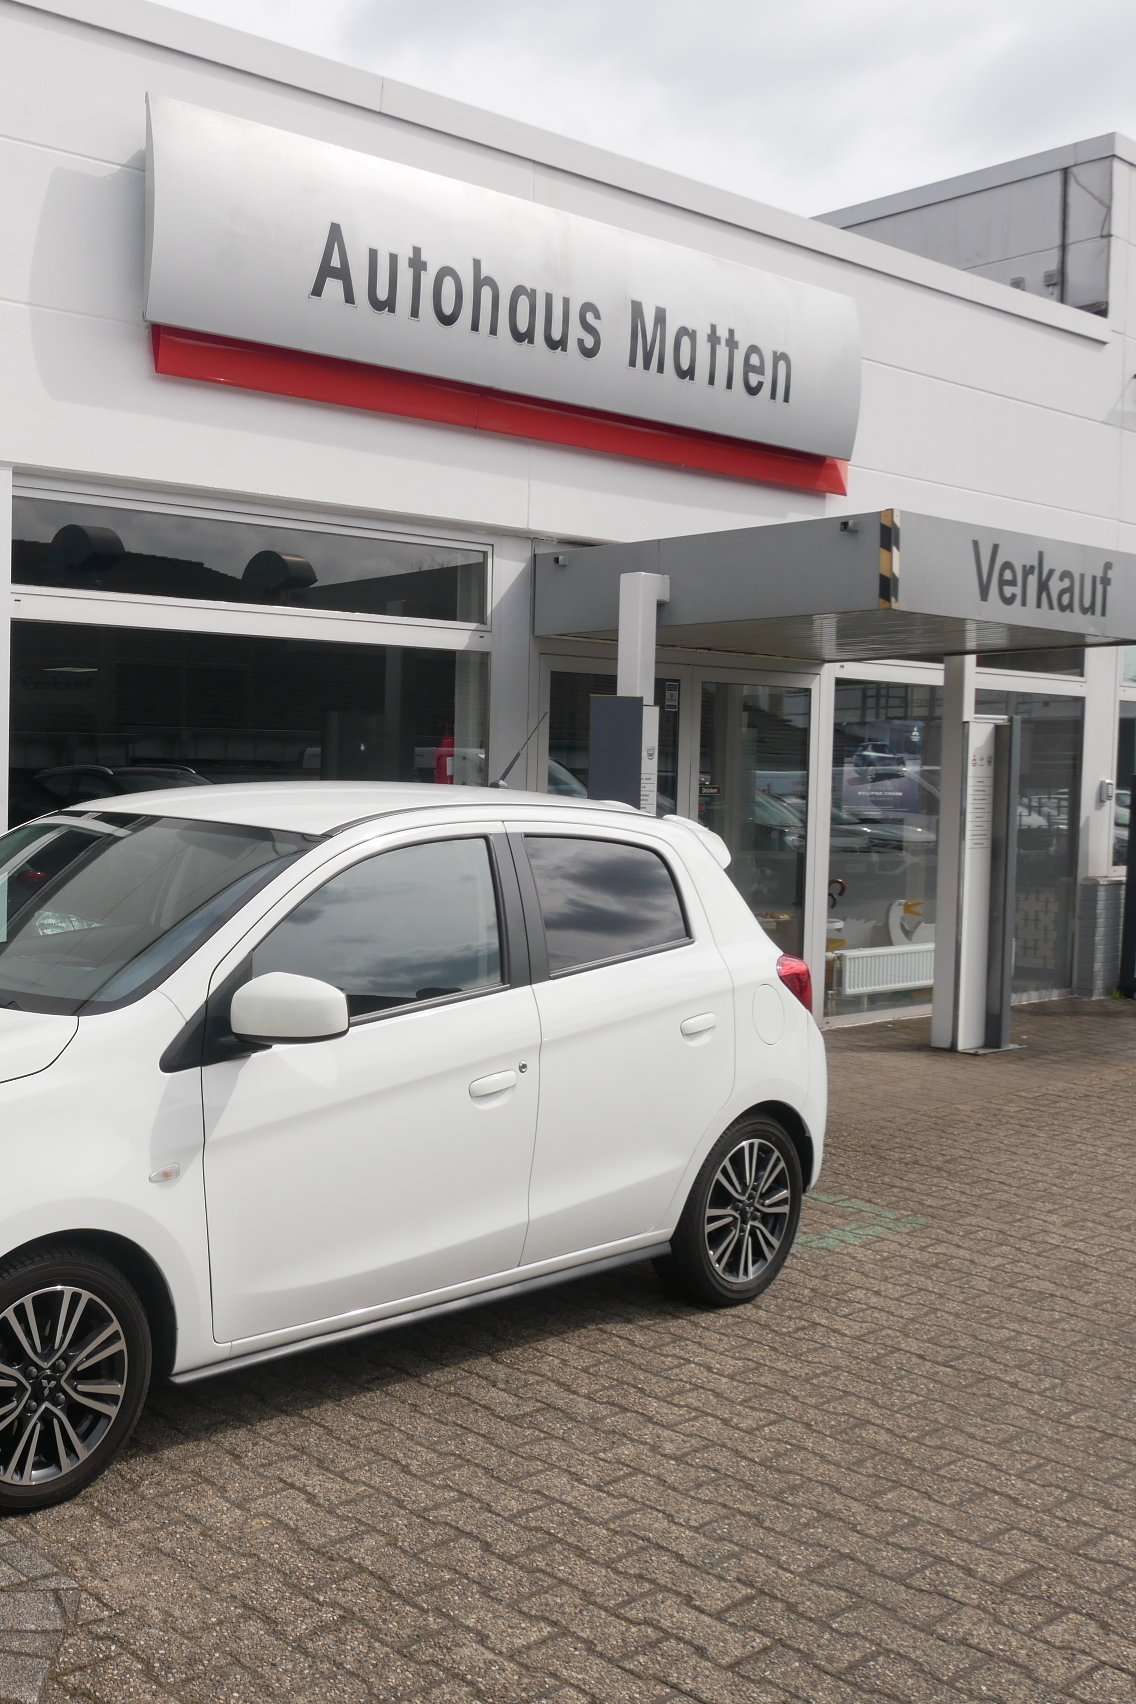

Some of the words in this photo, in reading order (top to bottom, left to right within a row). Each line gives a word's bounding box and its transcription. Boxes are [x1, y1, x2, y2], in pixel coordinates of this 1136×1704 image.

[310, 221, 602, 359] Autohaus
[628, 299, 792, 403] Matten
[972, 539, 1113, 617] Verkauf
